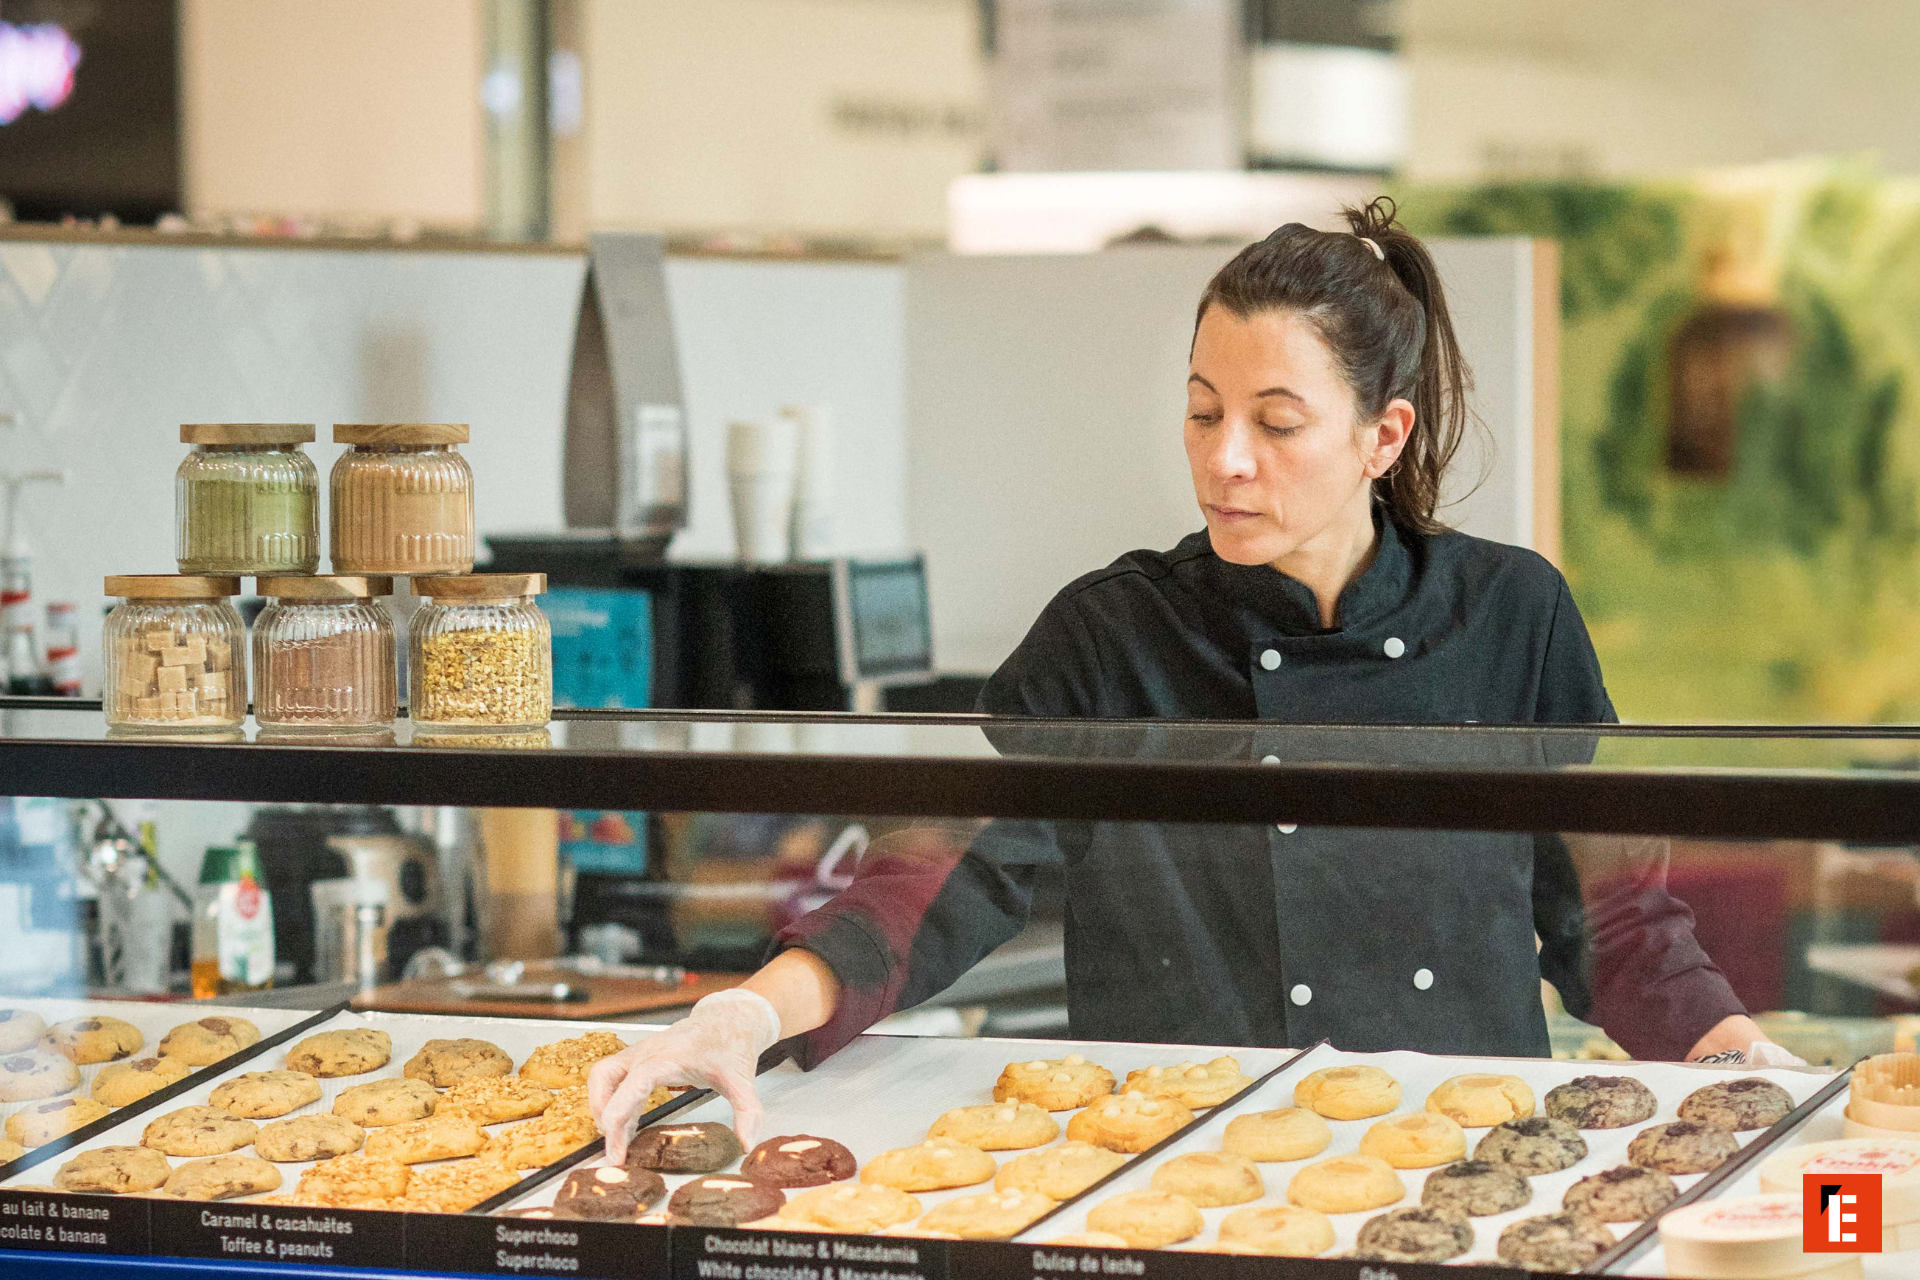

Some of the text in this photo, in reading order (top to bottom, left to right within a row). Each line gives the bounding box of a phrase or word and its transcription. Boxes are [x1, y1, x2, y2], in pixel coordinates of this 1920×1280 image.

[2, 1200, 110, 1220] au lait & banane
[201, 1210, 257, 1229] Caramel
[260, 1214, 272, 1230] &
[0, 1224, 107, 1244] colate & banana
[496, 1225, 579, 1247] Superchoco
[220, 1236, 334, 1259] Toffee & peanuts
[704, 1235, 919, 1264] Chocolat blanc & Macadamia
[496, 1249, 579, 1272] Superchoco
[697, 1259, 741, 1279] White
[745, 1262, 819, 1280] chocolate
[822, 1266, 835, 1280] &
[1032, 1250, 1146, 1276] Dulce de leche
